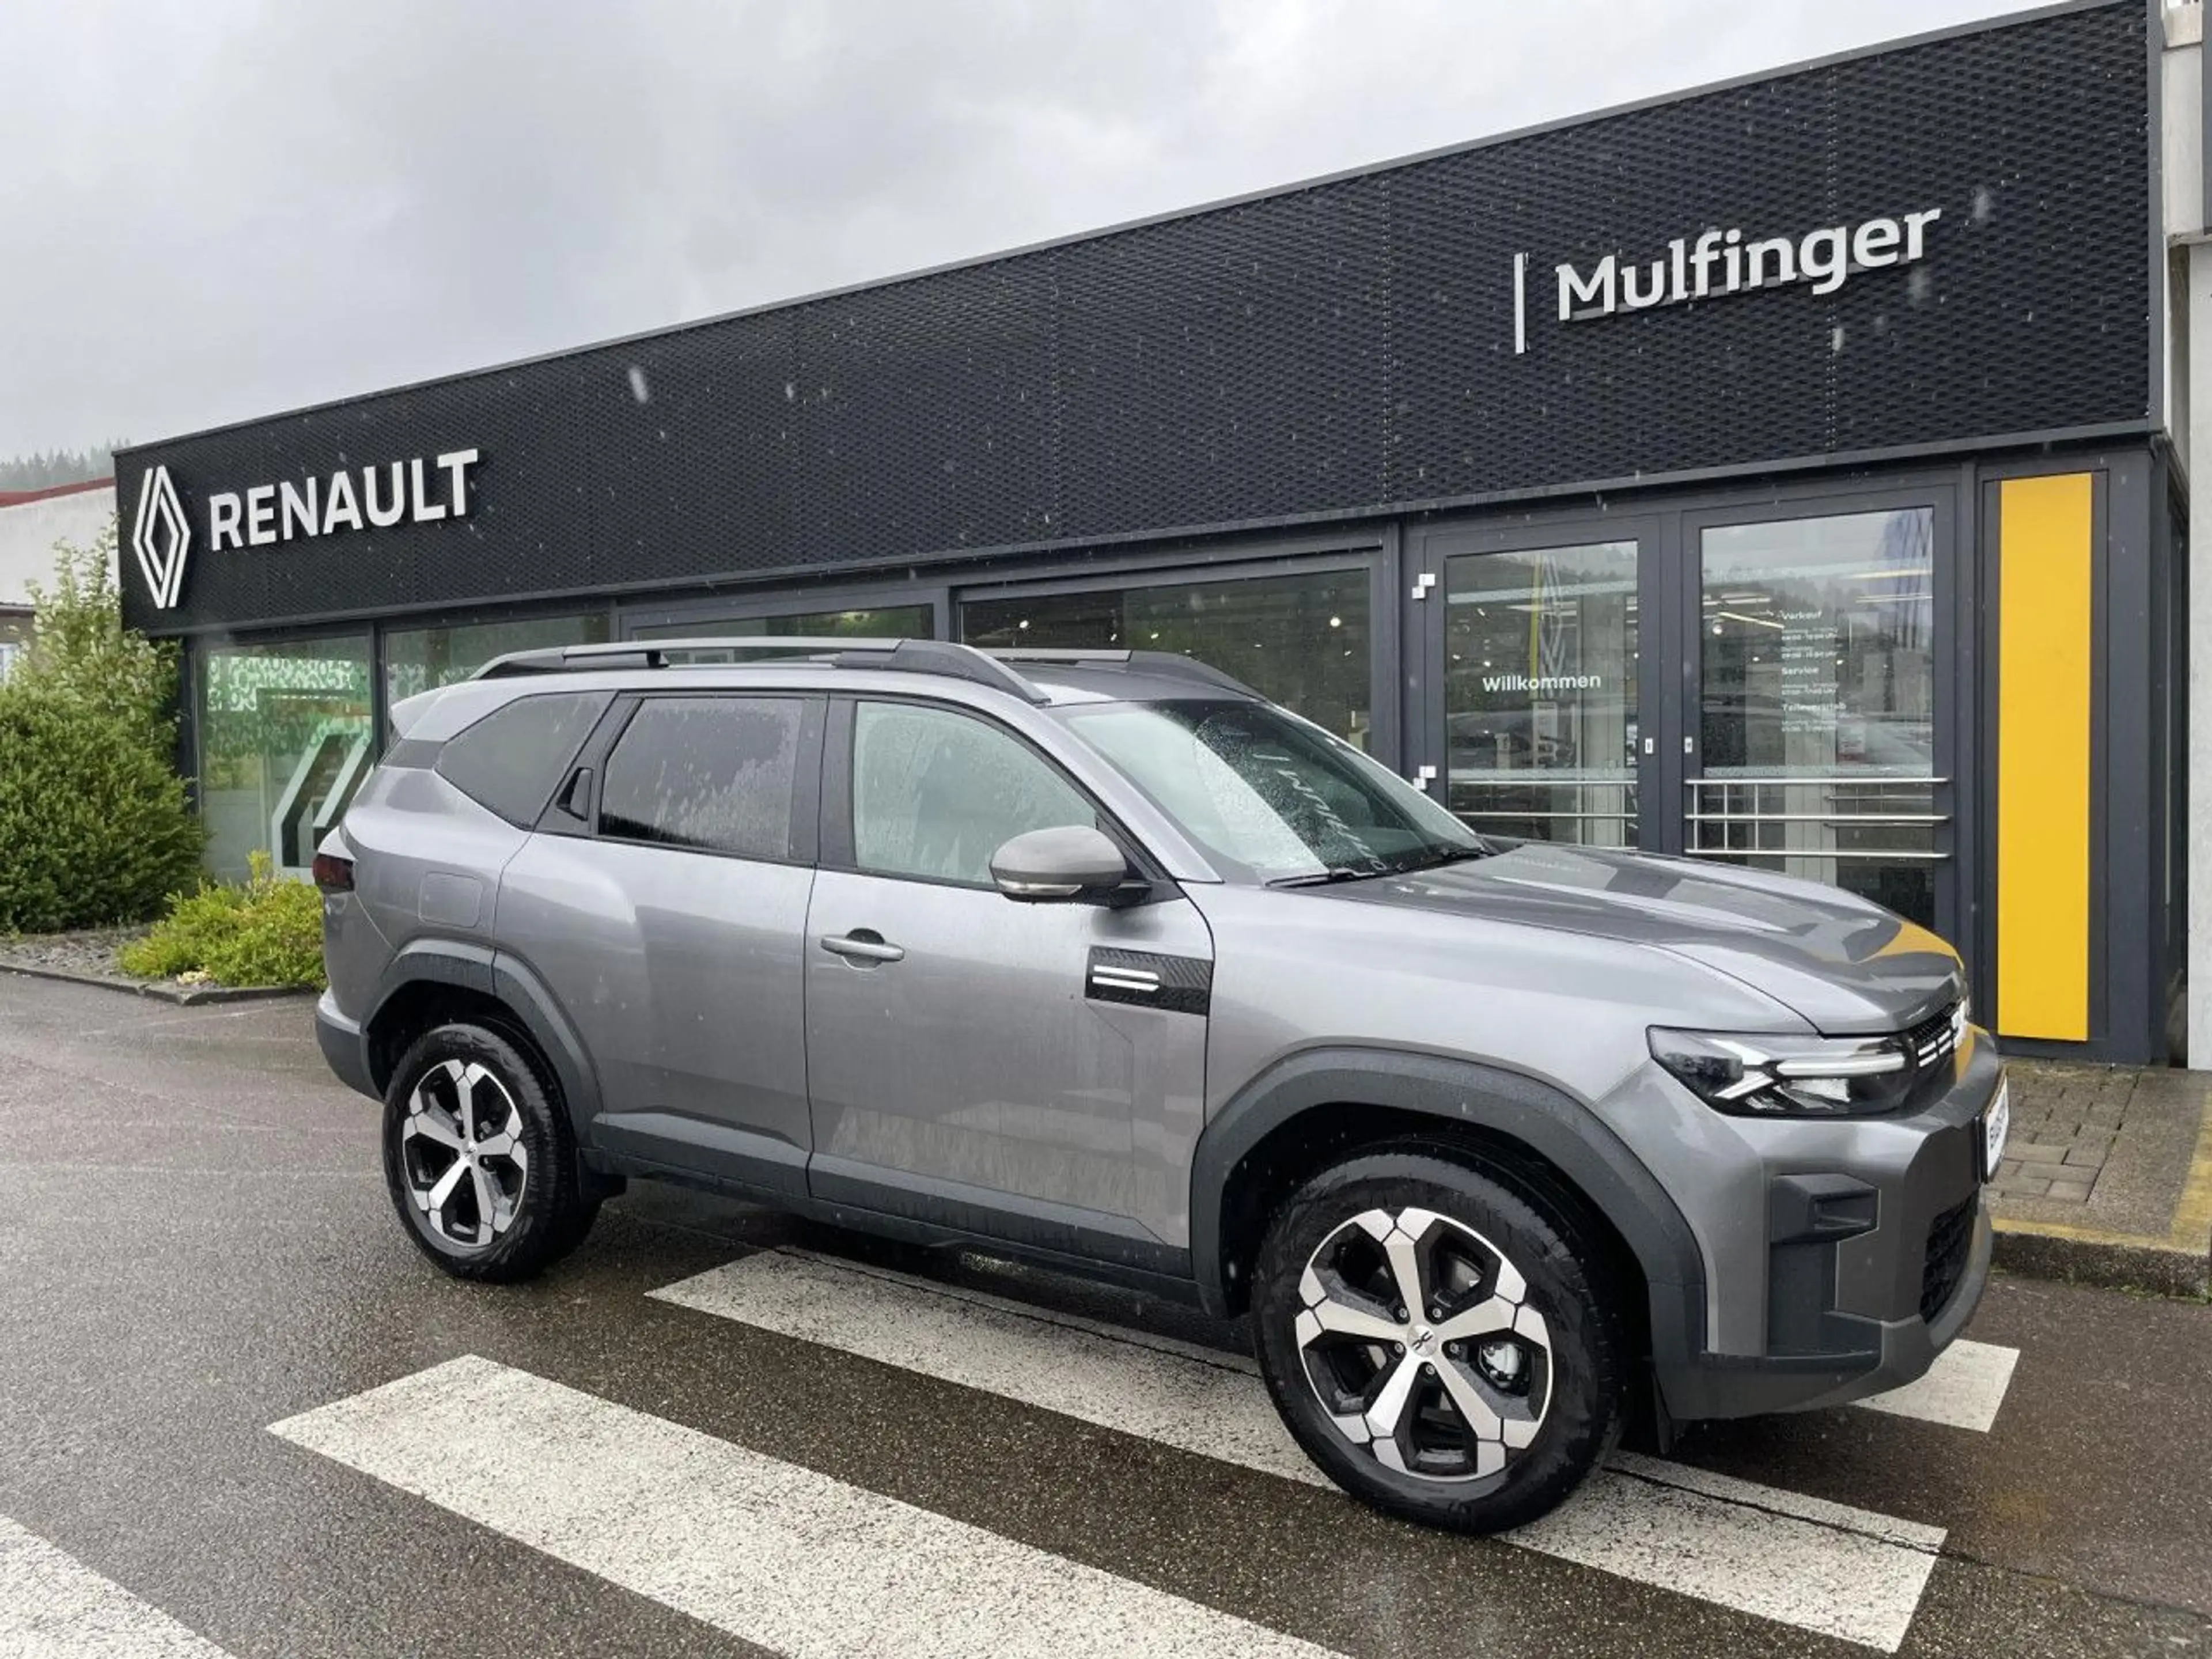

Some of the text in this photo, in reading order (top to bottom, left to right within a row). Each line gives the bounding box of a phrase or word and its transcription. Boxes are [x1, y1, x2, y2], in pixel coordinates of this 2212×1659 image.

[1555, 208, 1942, 321] Mulfinger
[209, 449, 479, 551] RENAULT
[1483, 675, 1602, 692] Willkommen
